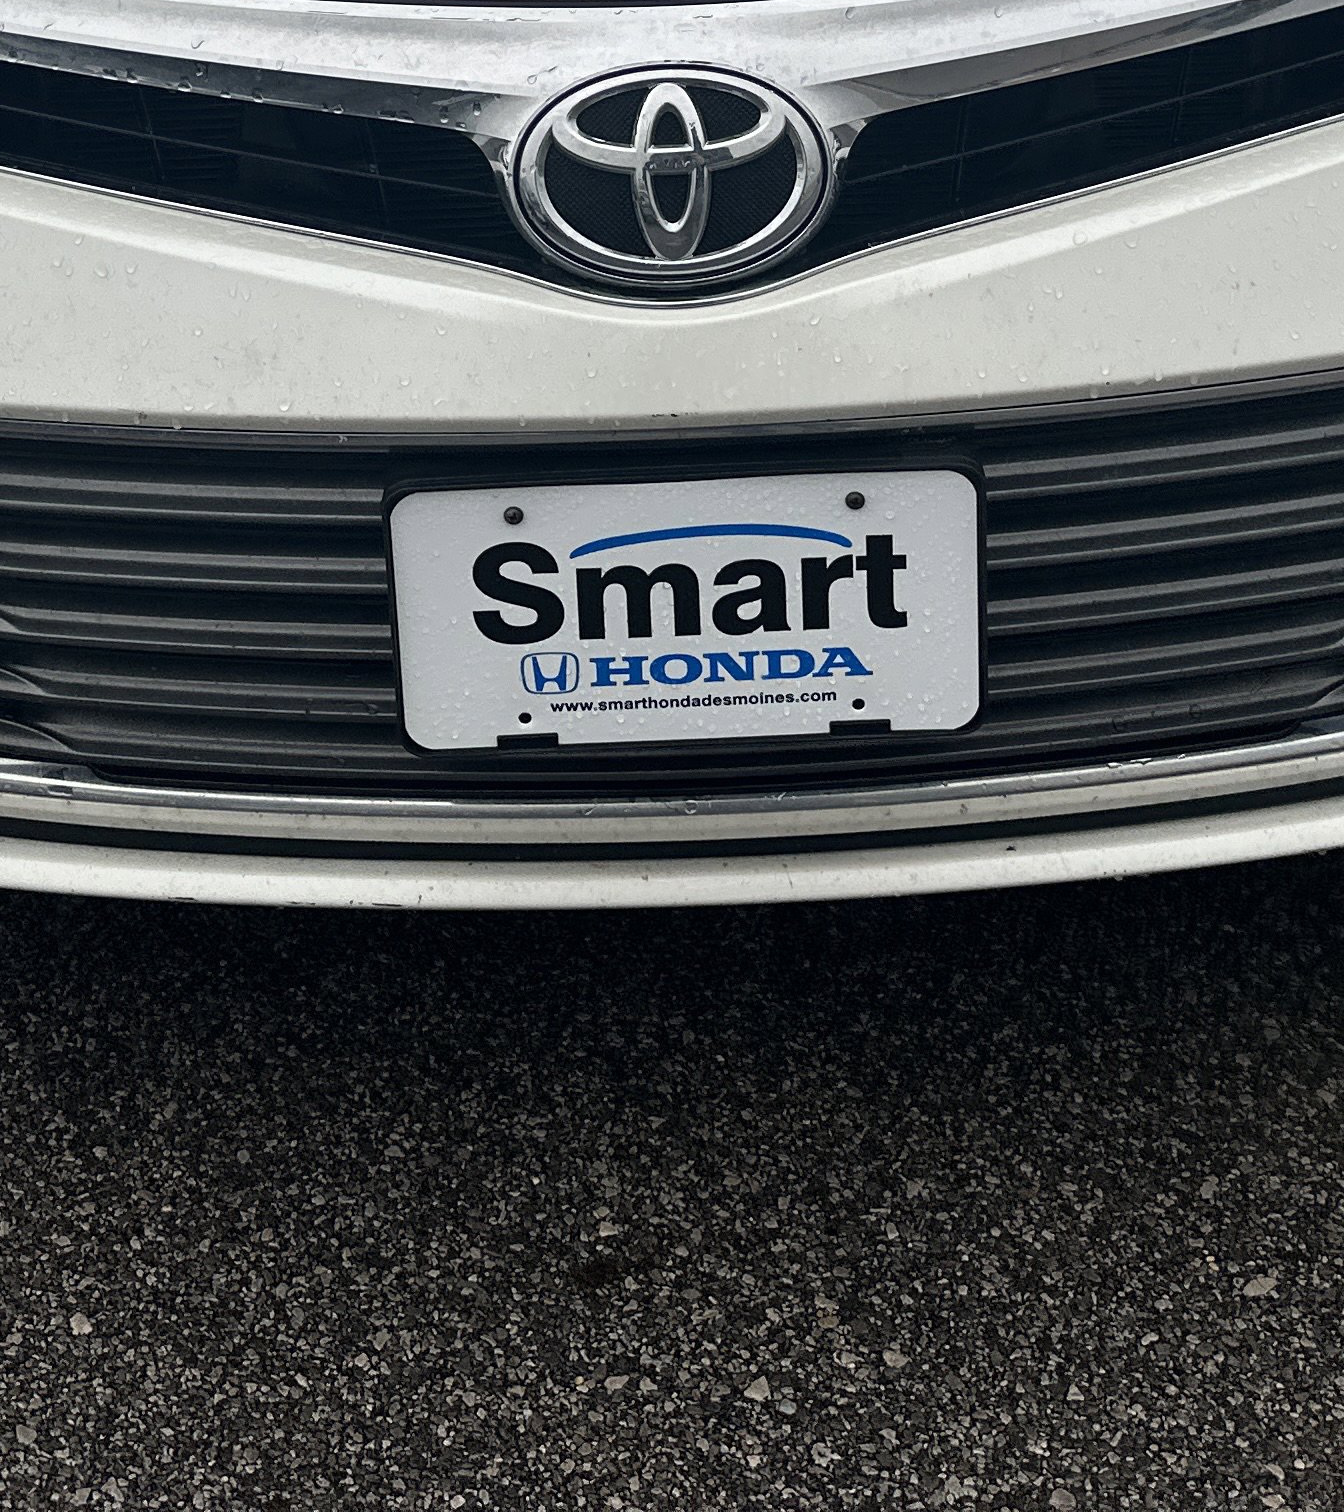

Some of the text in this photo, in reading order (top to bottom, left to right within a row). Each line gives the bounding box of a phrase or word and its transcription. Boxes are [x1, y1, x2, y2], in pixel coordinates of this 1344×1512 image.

[472, 534, 908, 645] Smart
[589, 646, 874, 687] HONDA
[550, 690, 837, 713] www.smarthondadesmoines.com
